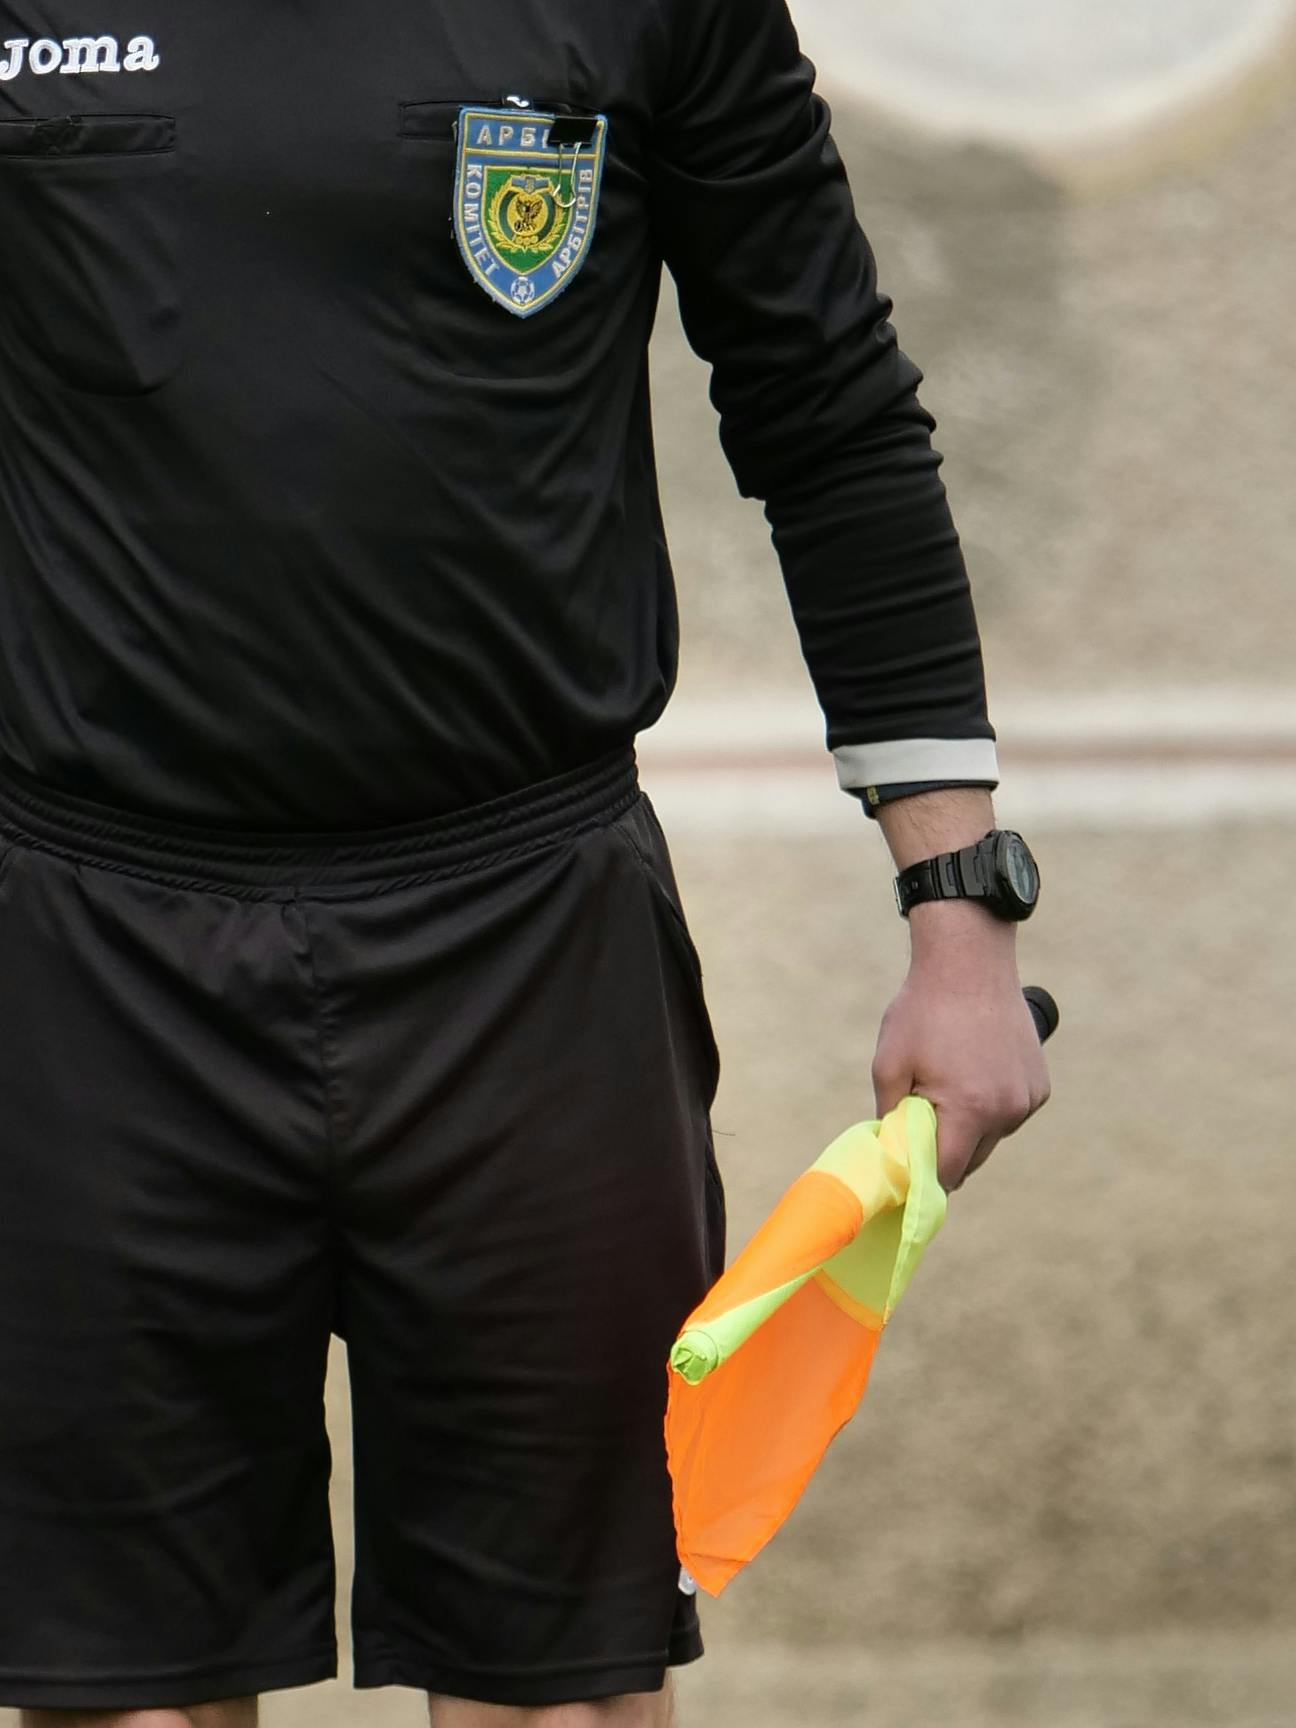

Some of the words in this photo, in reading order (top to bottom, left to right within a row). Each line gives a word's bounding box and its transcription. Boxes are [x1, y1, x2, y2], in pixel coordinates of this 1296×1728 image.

[475, 124, 550, 149] АРБІ
[464, 164, 499, 276] КОМІТЕТ
[552, 169, 593, 279] АРБІТРІВ
